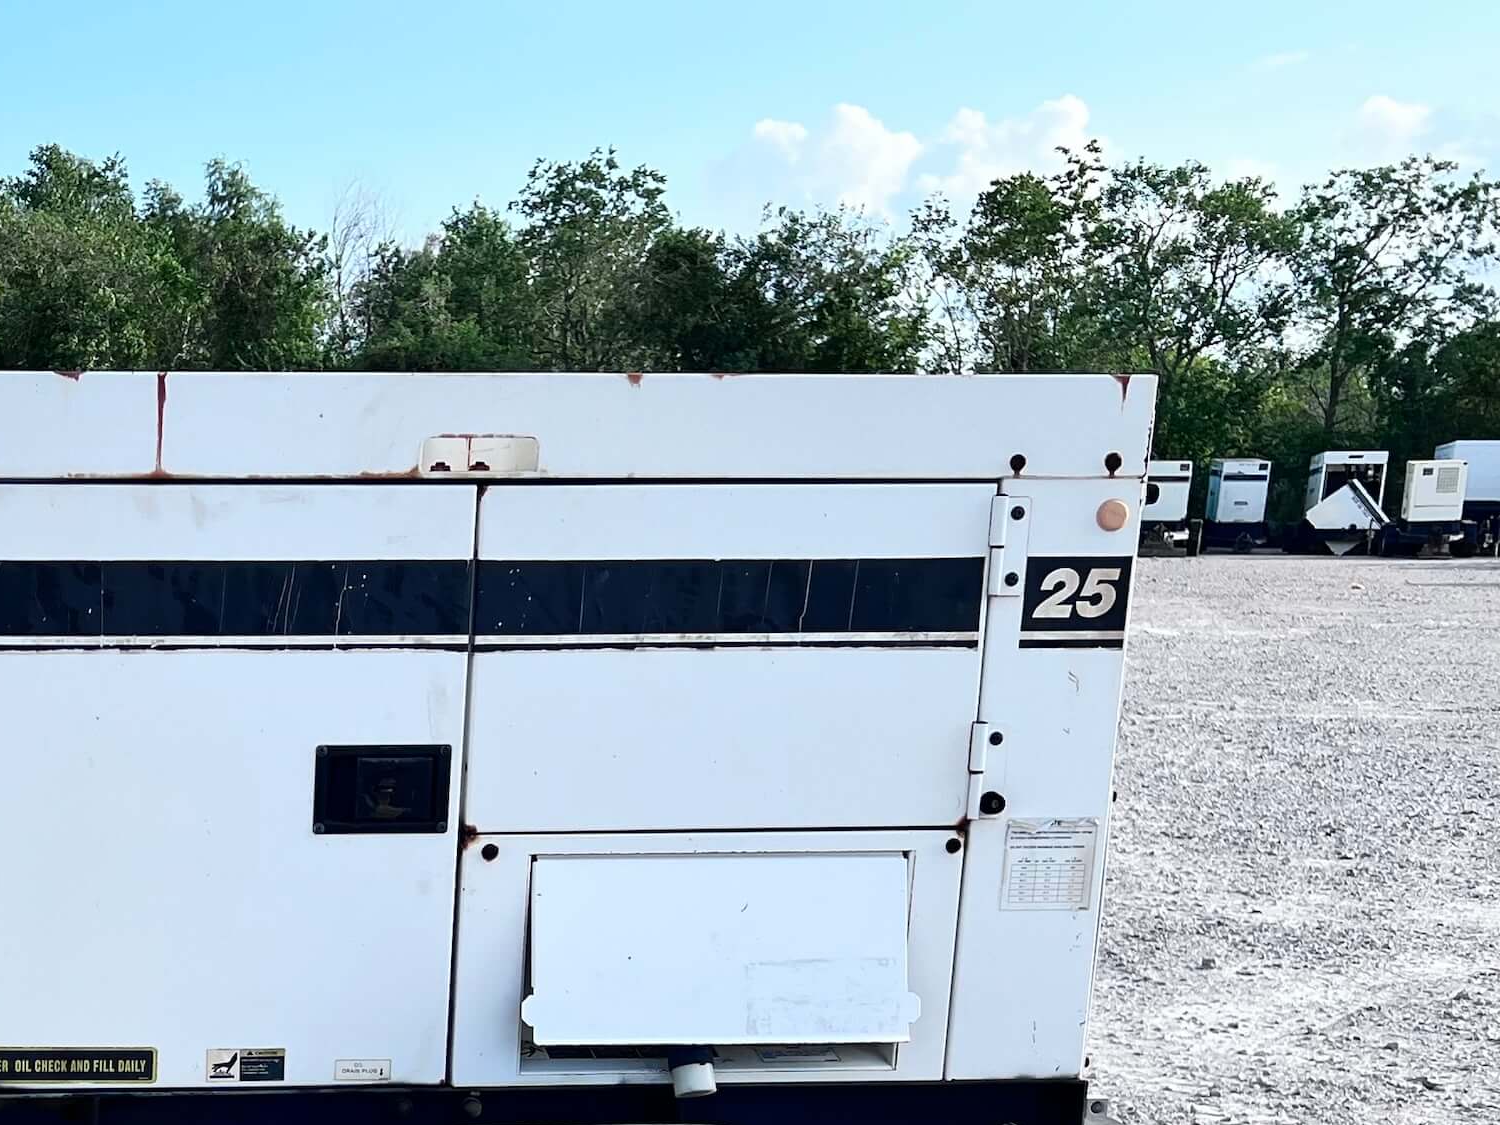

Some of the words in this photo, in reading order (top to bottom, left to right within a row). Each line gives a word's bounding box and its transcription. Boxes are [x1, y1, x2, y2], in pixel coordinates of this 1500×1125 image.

[1032, 567, 1121, 618] 25
[14, 1059, 32, 1073] OIL
[34, 1059, 68, 1073] CHECK
[70, 1059, 90, 1073] AND
[92, 1059, 115, 1073] FILL
[117, 1059, 146, 1073] DAILY
